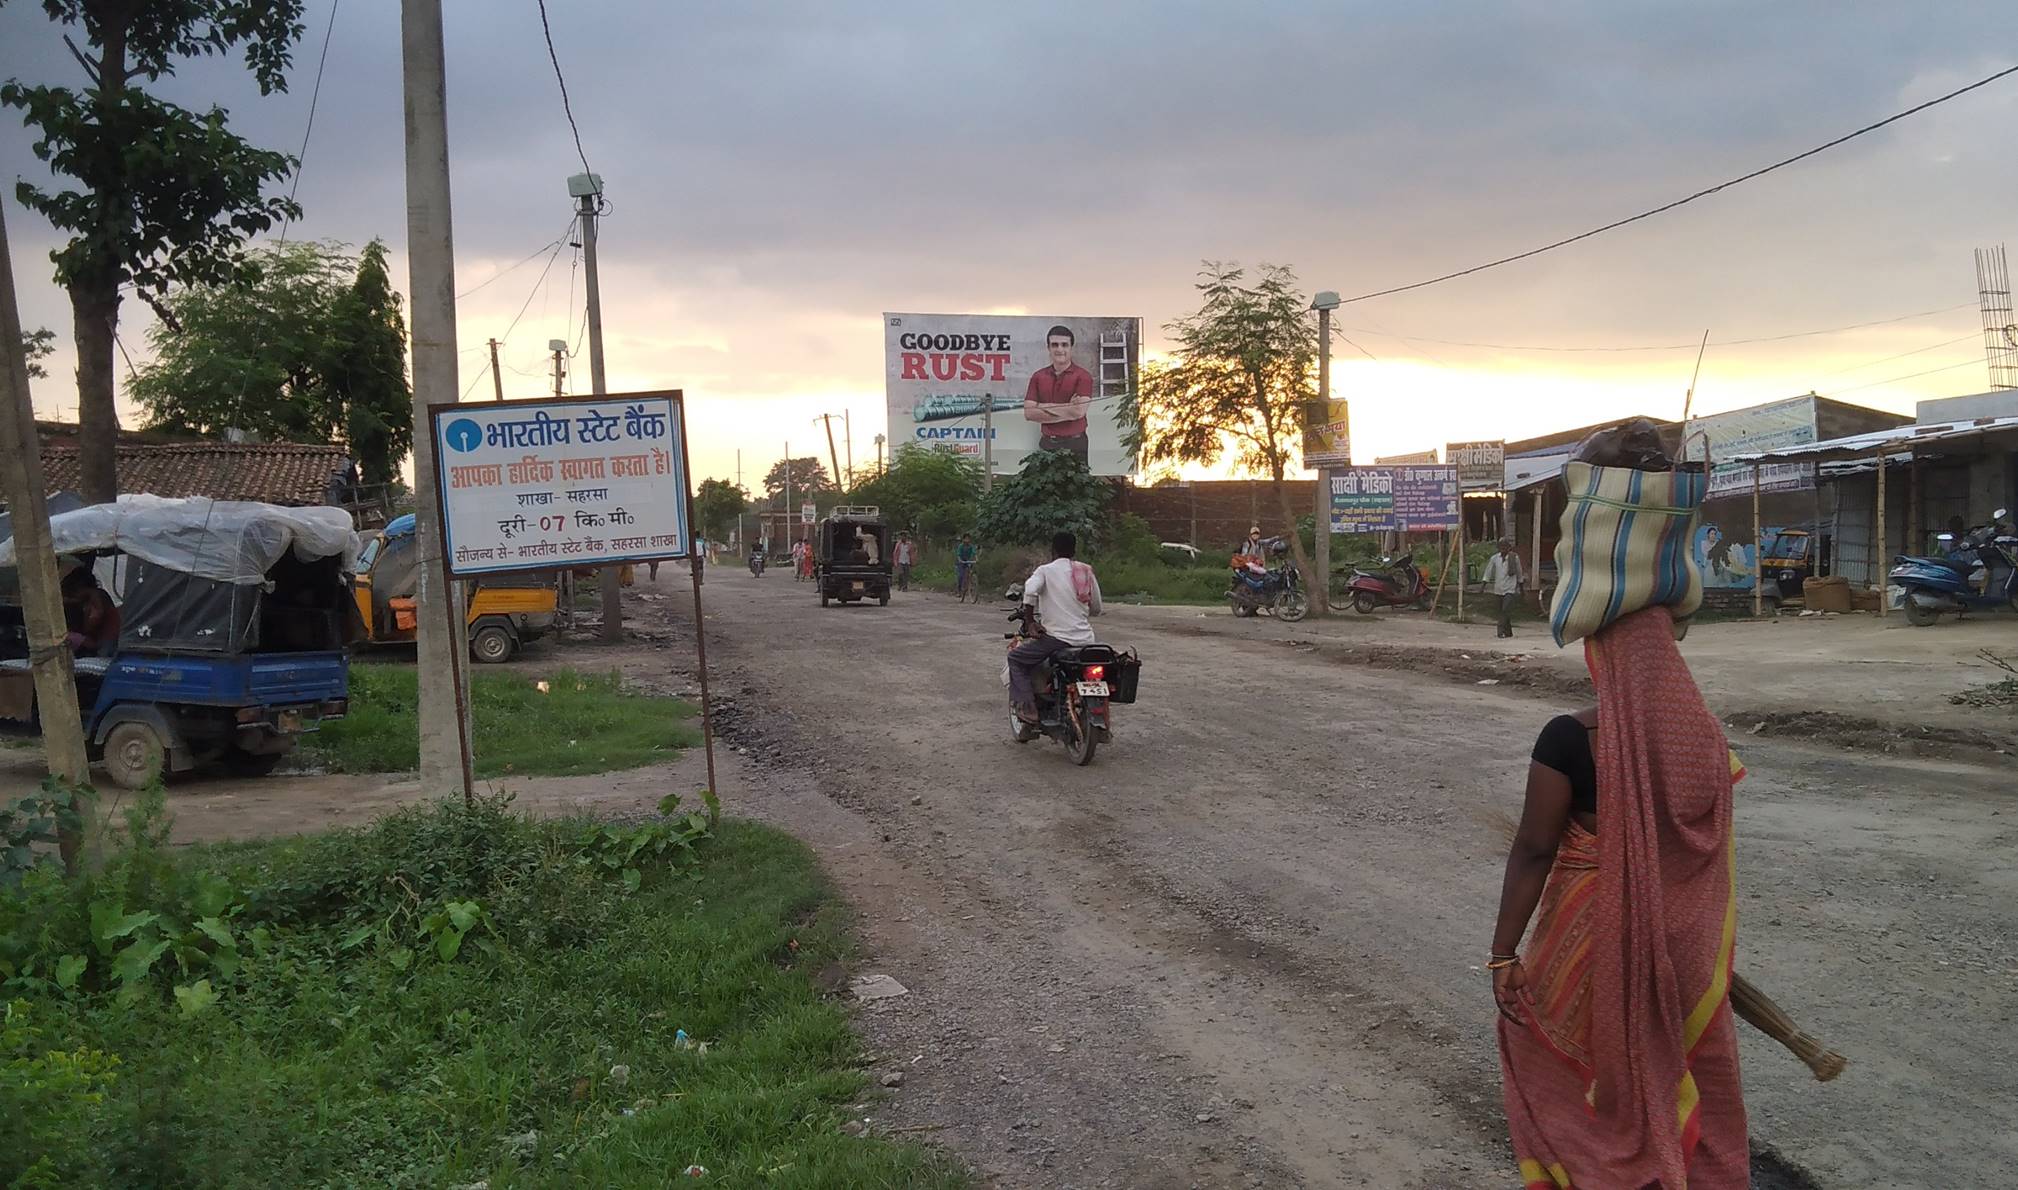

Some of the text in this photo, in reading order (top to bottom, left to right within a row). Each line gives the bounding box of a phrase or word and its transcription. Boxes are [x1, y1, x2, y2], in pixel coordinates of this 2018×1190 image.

[900, 333, 1010, 351] GOODBYE
[901, 352, 1010, 381] RUST
[487, 404, 665, 448] भारतीय स्टेट बैंक
[916, 427, 996, 439] CAPTAIN
[451, 464, 502, 488] आपका
[507, 455, 554, 484] हार्दिक
[559, 457, 605, 480] स्वागत
[609, 454, 649, 477] करता
[1331, 472, 1393, 494] साक्षी मेडिको
[565, 488, 608, 503] सहरसा
[455, 545, 493, 562] सौजन्य
[519, 540, 557, 557] भारतीय
[561, 537, 582, 554] स्टेट
[610, 536, 646, 550] सहरसा
[651, 535, 677, 547] शाखा
